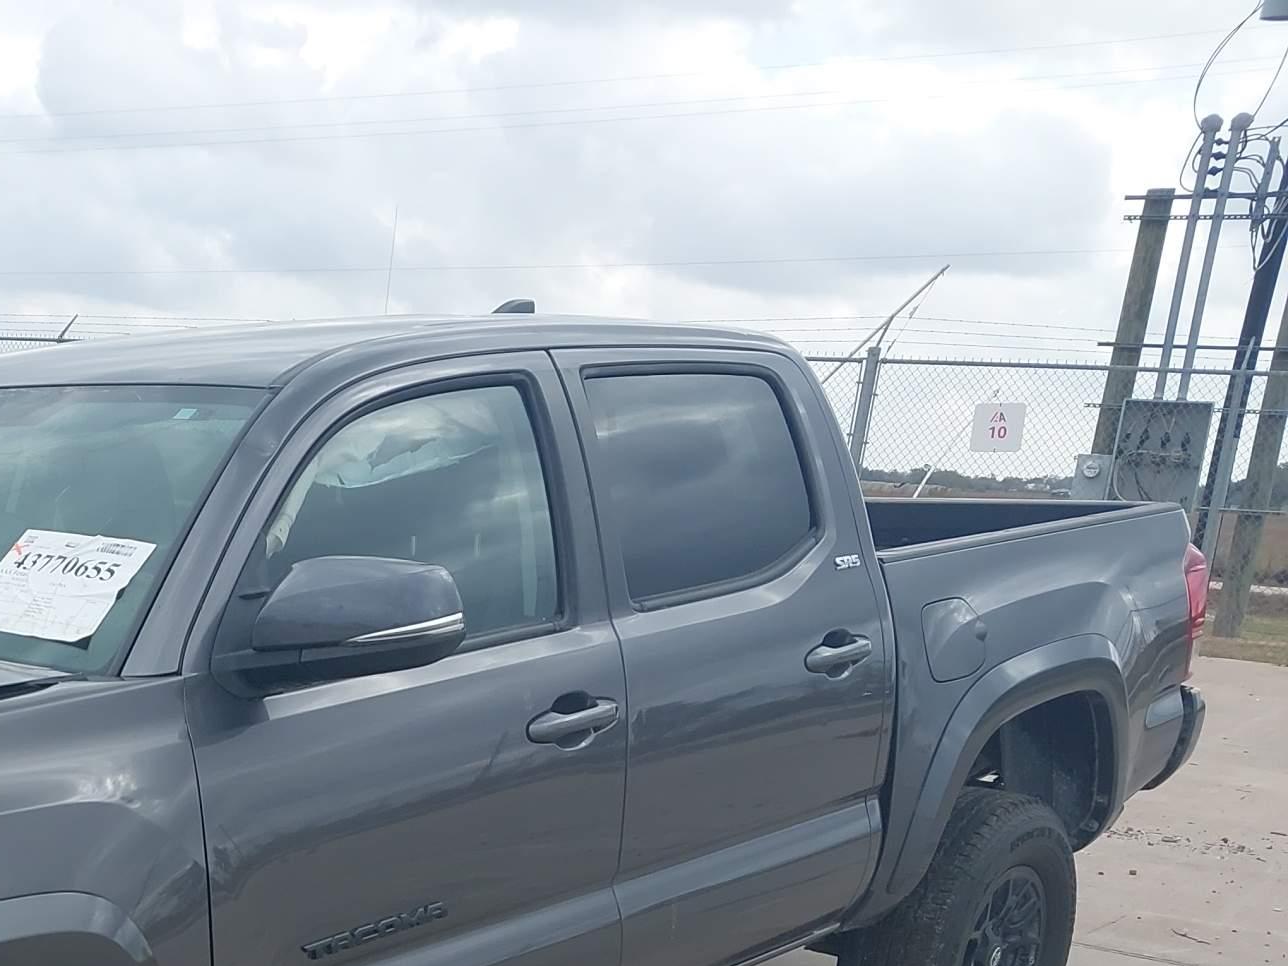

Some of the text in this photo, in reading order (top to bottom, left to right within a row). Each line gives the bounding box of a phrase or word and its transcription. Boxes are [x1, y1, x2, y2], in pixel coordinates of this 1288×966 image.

[988, 426, 1007, 439] 10
[14, 551, 121, 581] 43770655
[835, 554, 861, 570] SR5
[300, 901, 448, 960] TACOMA
